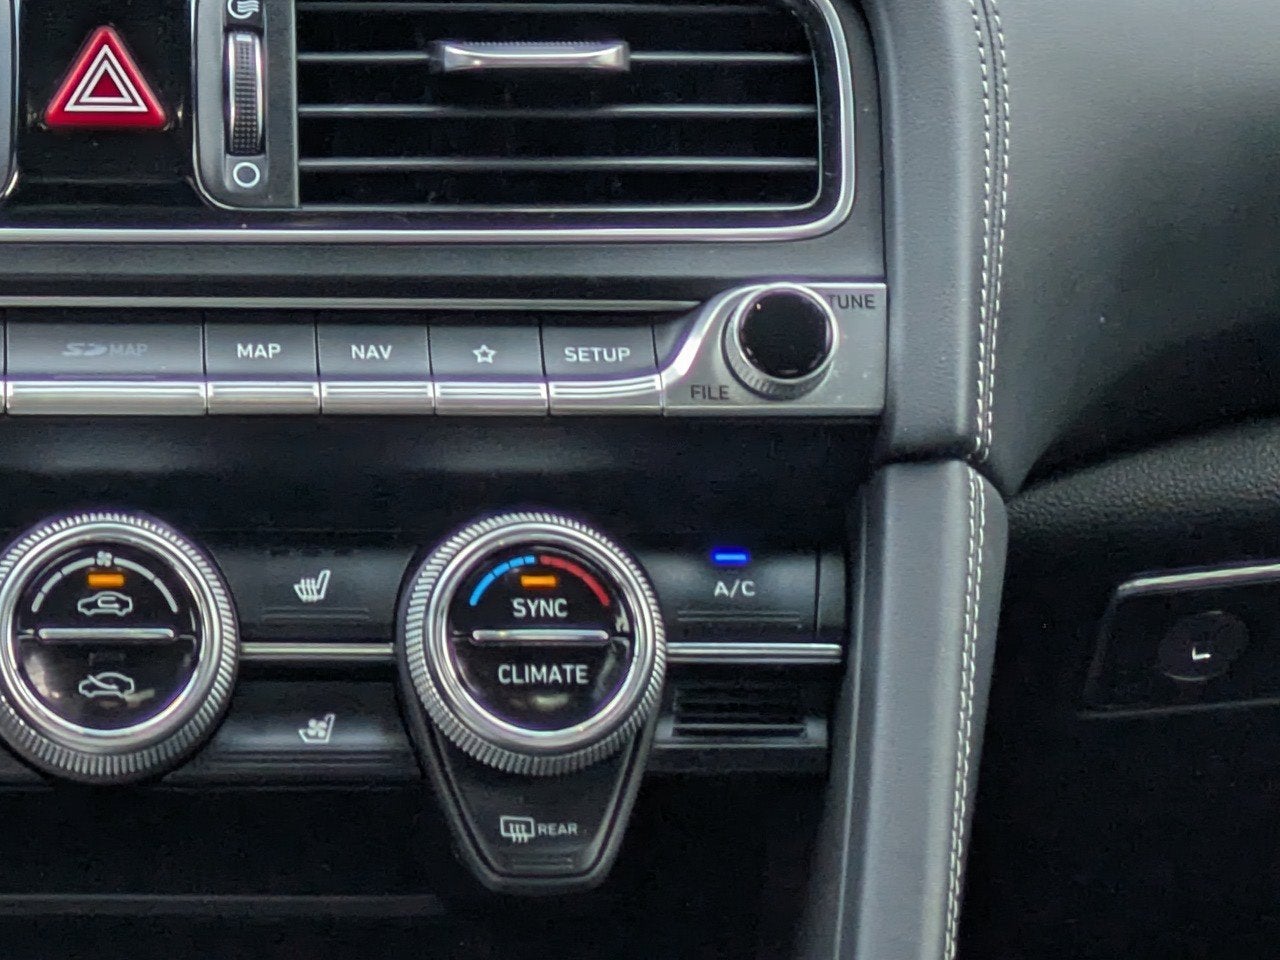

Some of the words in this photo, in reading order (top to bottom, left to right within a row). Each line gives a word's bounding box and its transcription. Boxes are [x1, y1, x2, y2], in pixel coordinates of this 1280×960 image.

[827, 293, 876, 309] TUNE
[236, 343, 282, 360] MAP
[351, 344, 393, 360] NAV
[564, 346, 632, 363] SETUP
[690, 384, 731, 401] FILE
[715, 580, 756, 598] A/C
[512, 598, 568, 619] SYNC
[498, 664, 589, 685] CLIMATE
[538, 822, 578, 836] REAR
